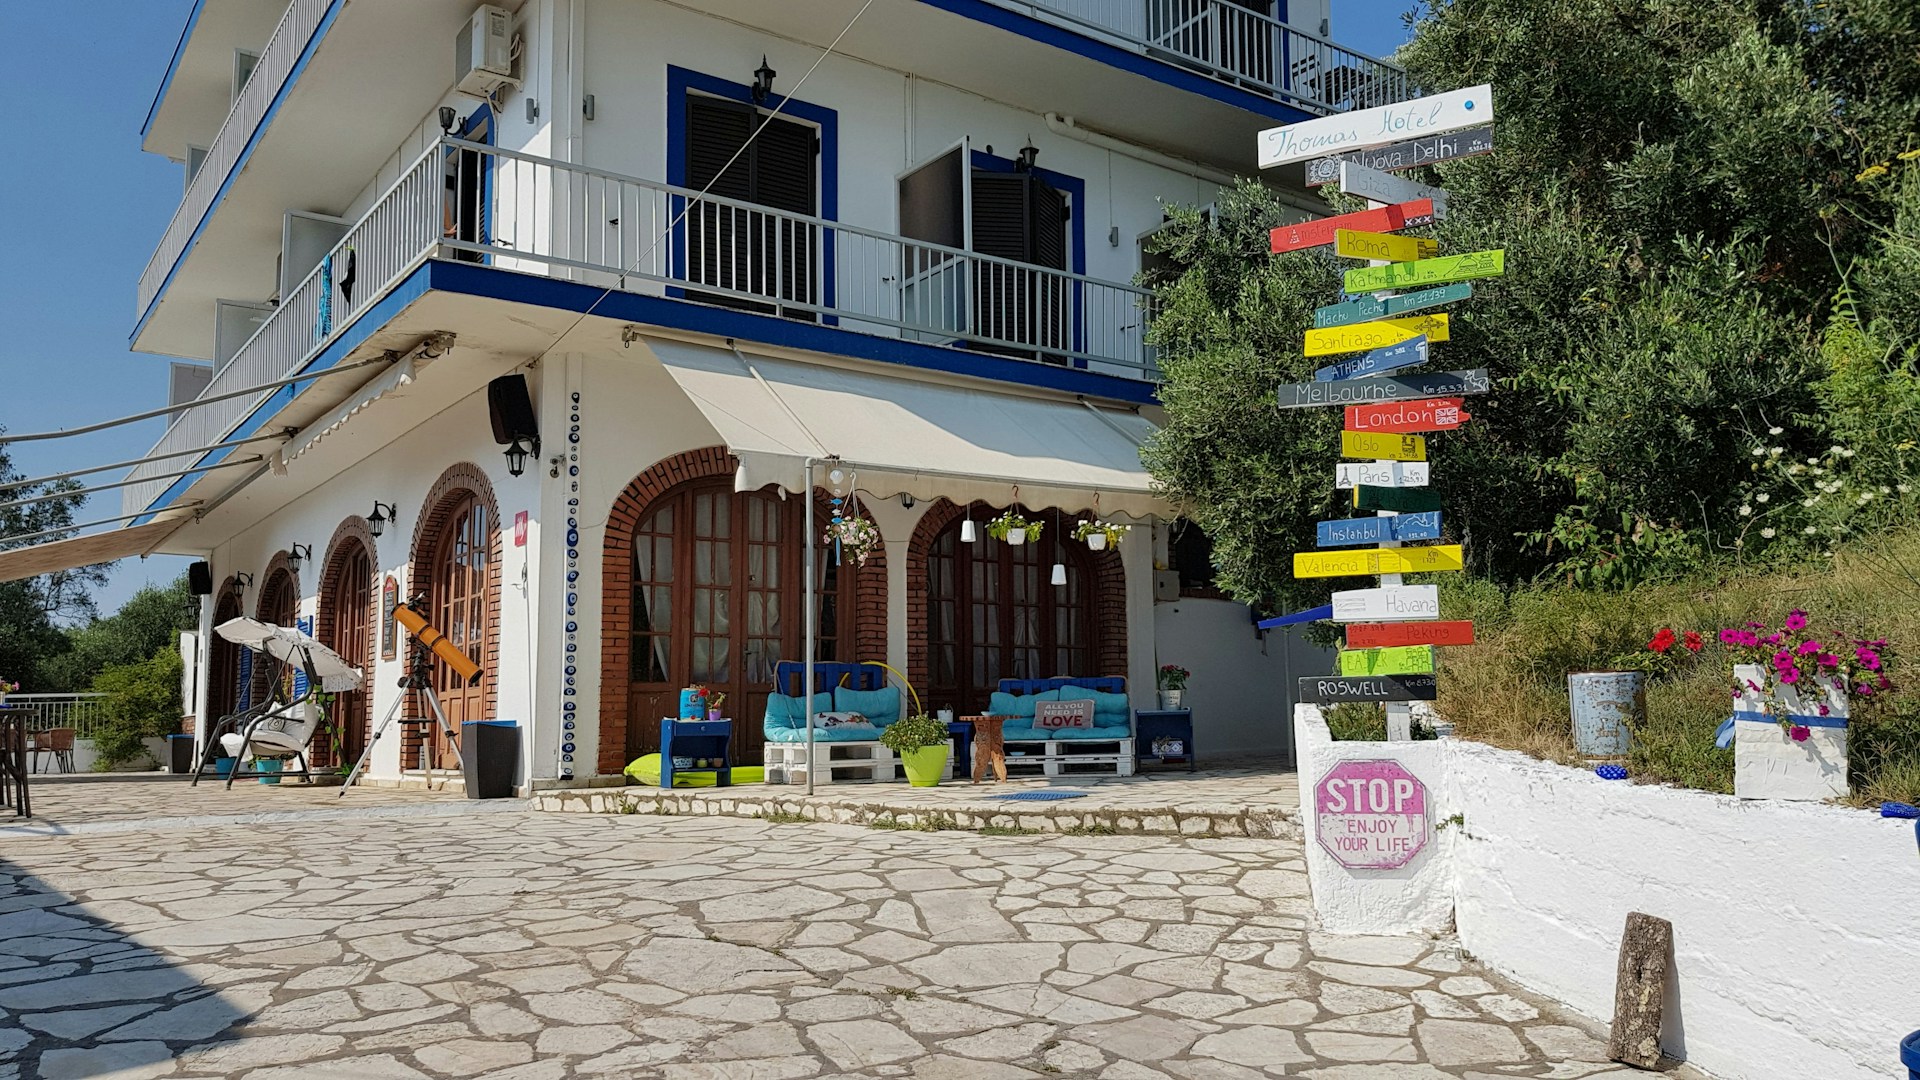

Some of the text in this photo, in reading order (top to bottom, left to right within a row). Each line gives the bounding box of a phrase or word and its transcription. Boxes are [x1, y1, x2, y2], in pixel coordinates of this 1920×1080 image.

[1268, 101, 1443, 158] Thomas Hotel
[1352, 151, 1403, 169] Nuova
[1414, 138, 1457, 164] Delhi
[1357, 170, 1392, 198] Giza
[1346, 232, 1390, 257] Roma
[1350, 267, 1420, 288] Katmandu
[1317, 310, 1349, 327] Machu
[1358, 301, 1385, 316] Picchu
[1312, 331, 1383, 350] Santiago
[1331, 355, 1375, 378] ATHENS
[1295, 382, 1468, 404] Melbourne Km 15.331
[1355, 405, 1433, 428] London
[1353, 434, 1379, 452] Oslo
[1359, 464, 1390, 483] Paris
[1328, 518, 1380, 541] Instanbul
[1301, 558, 1359, 574] Valencia
[1386, 594, 1437, 613] Havana
[1406, 625, 1450, 641] Peking
[1346, 651, 1388, 671] EASTER
[1317, 680, 1389, 697] ROSWELL
[1064, 702, 1084, 710] YOU
[1043, 715, 1083, 727] LOVE
[1325, 778, 1414, 813] STOP
[1347, 819, 1397, 834] ENJOY
[1335, 837, 1411, 852] YOUR LIFE
